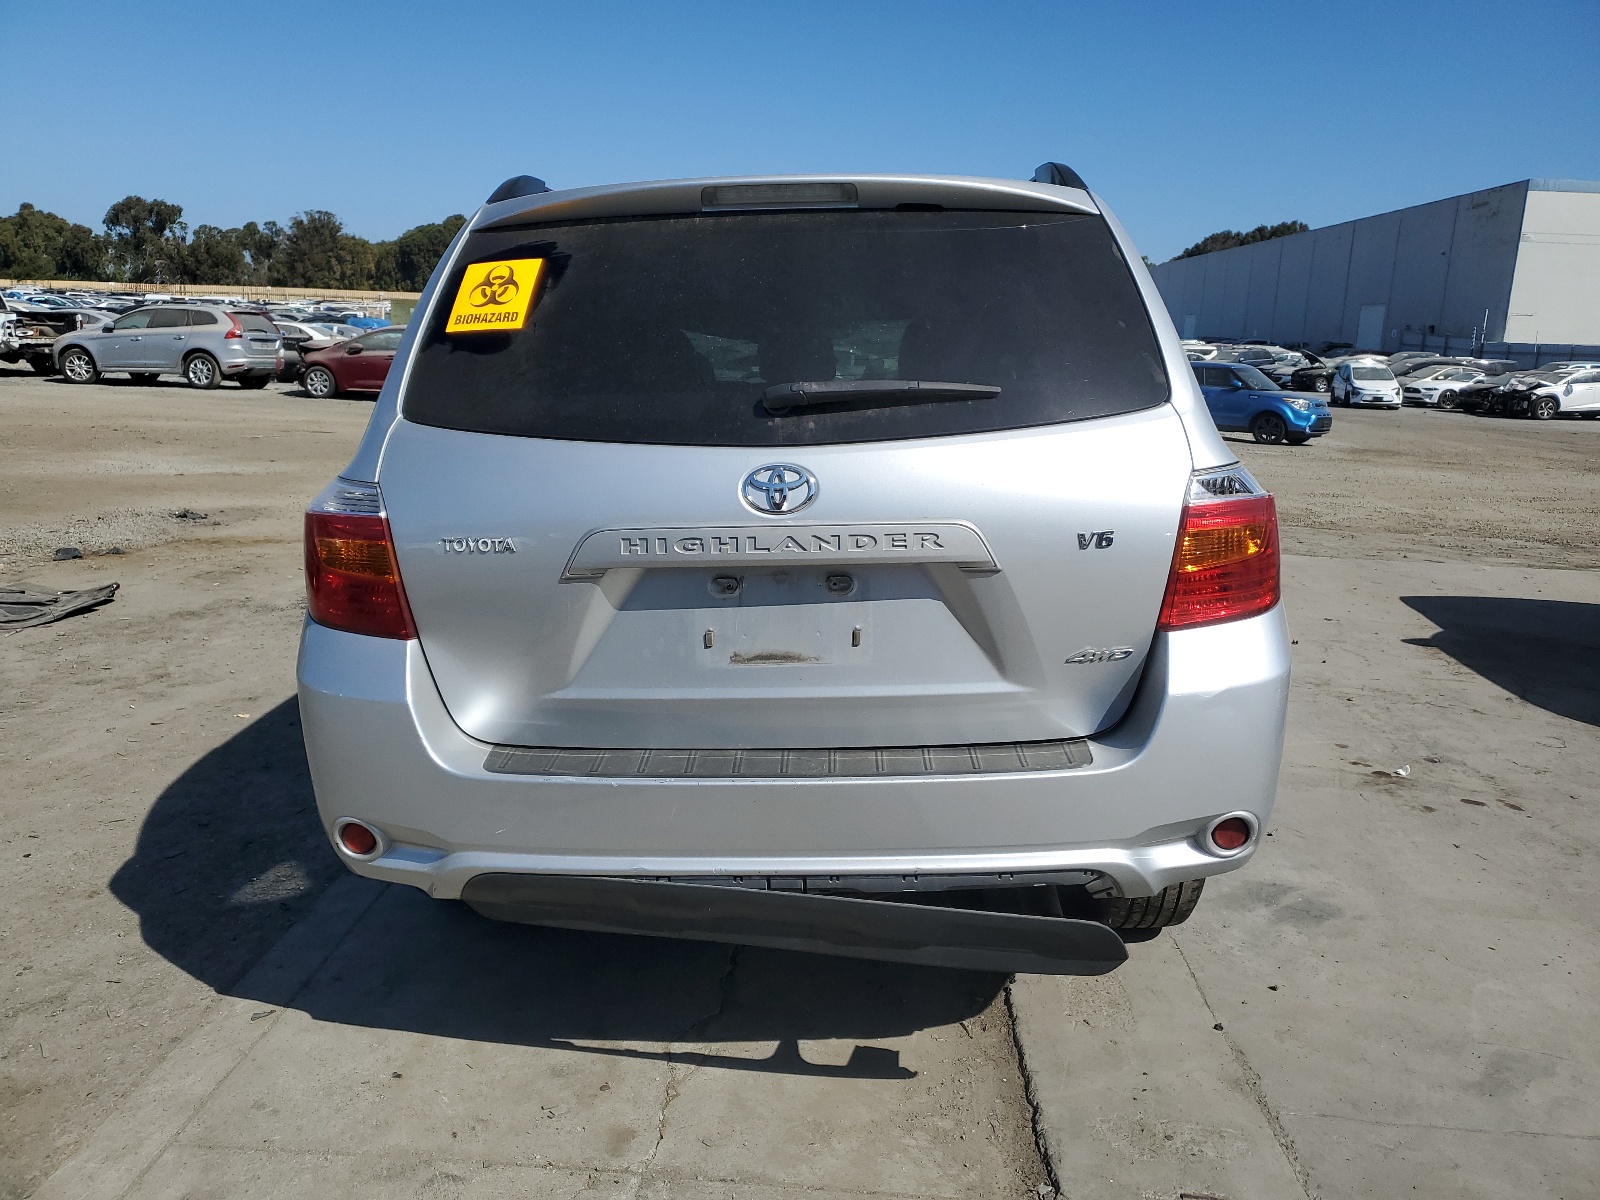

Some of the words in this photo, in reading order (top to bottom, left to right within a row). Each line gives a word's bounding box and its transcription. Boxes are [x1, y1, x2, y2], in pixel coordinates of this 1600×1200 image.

[453, 311, 519, 326] BIOHAZARD
[442, 536, 517, 552] TOYOTA
[620, 532, 945, 555] HIGHLANDER
[1077, 530, 1115, 551] V6
[1064, 647, 1134, 665] 4WD
